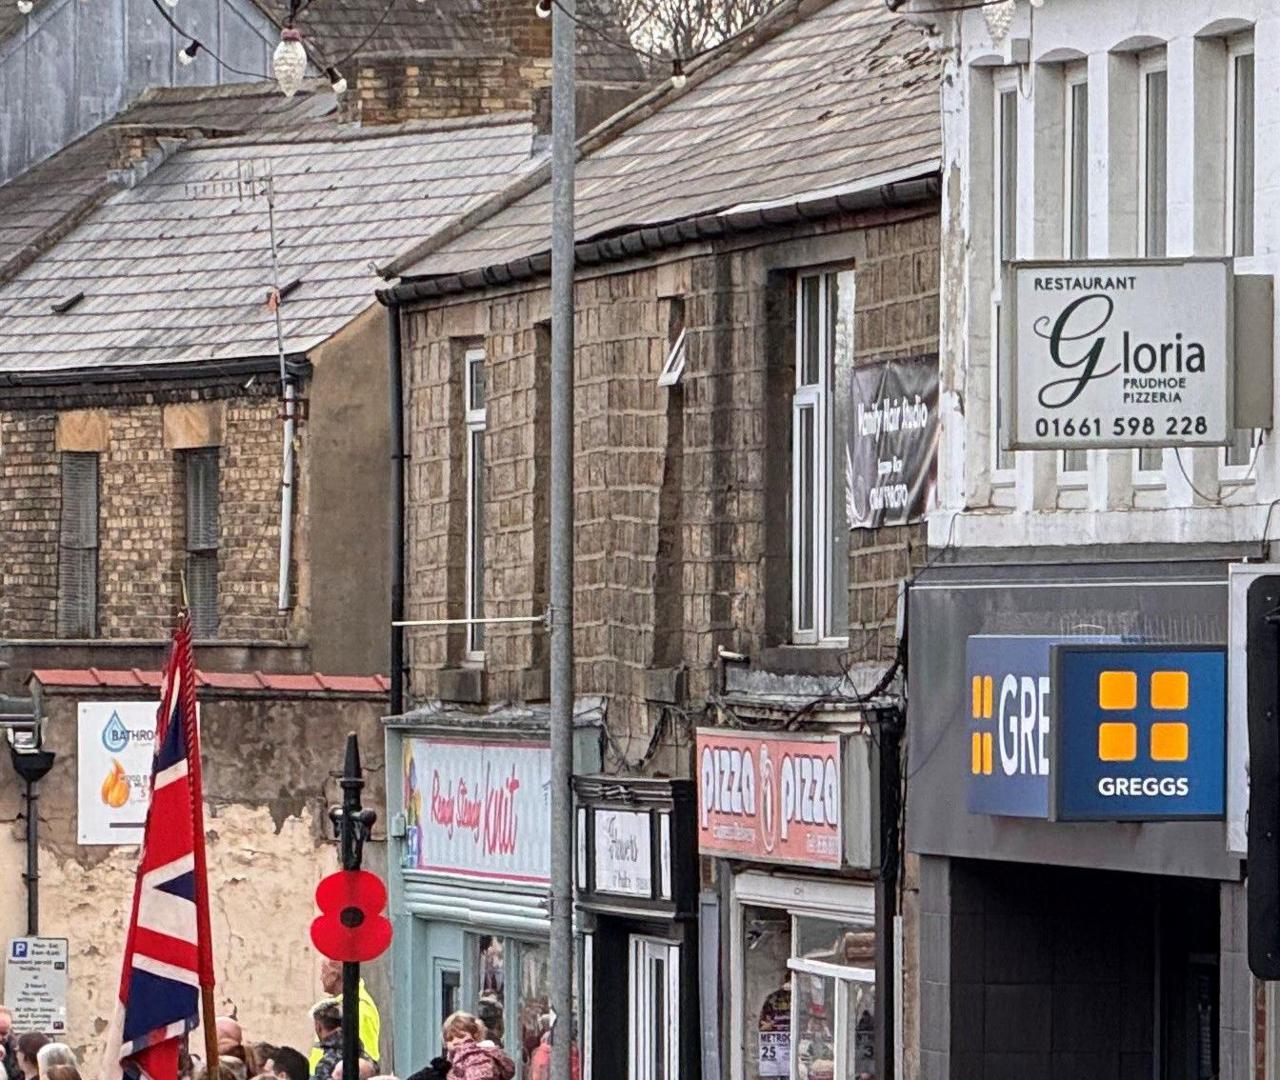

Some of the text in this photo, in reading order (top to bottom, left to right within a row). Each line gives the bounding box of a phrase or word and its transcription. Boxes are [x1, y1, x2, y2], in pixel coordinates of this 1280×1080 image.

[1034, 276, 1137, 291] RESTAURANT
[1033, 294, 1206, 409] Gloria
[1123, 378, 1187, 390] PRUDHOE
[1123, 392, 1183, 404] PIZZERIA
[884, 397, 901, 432] Hair
[1035, 415, 1208, 438] 01661 598 228
[998, 673, 1051, 776] GRE
[111, 730, 155, 742] BATHRO
[1097, 776, 1190, 797] GREGGS
[761, 1047, 777, 1059] 25
